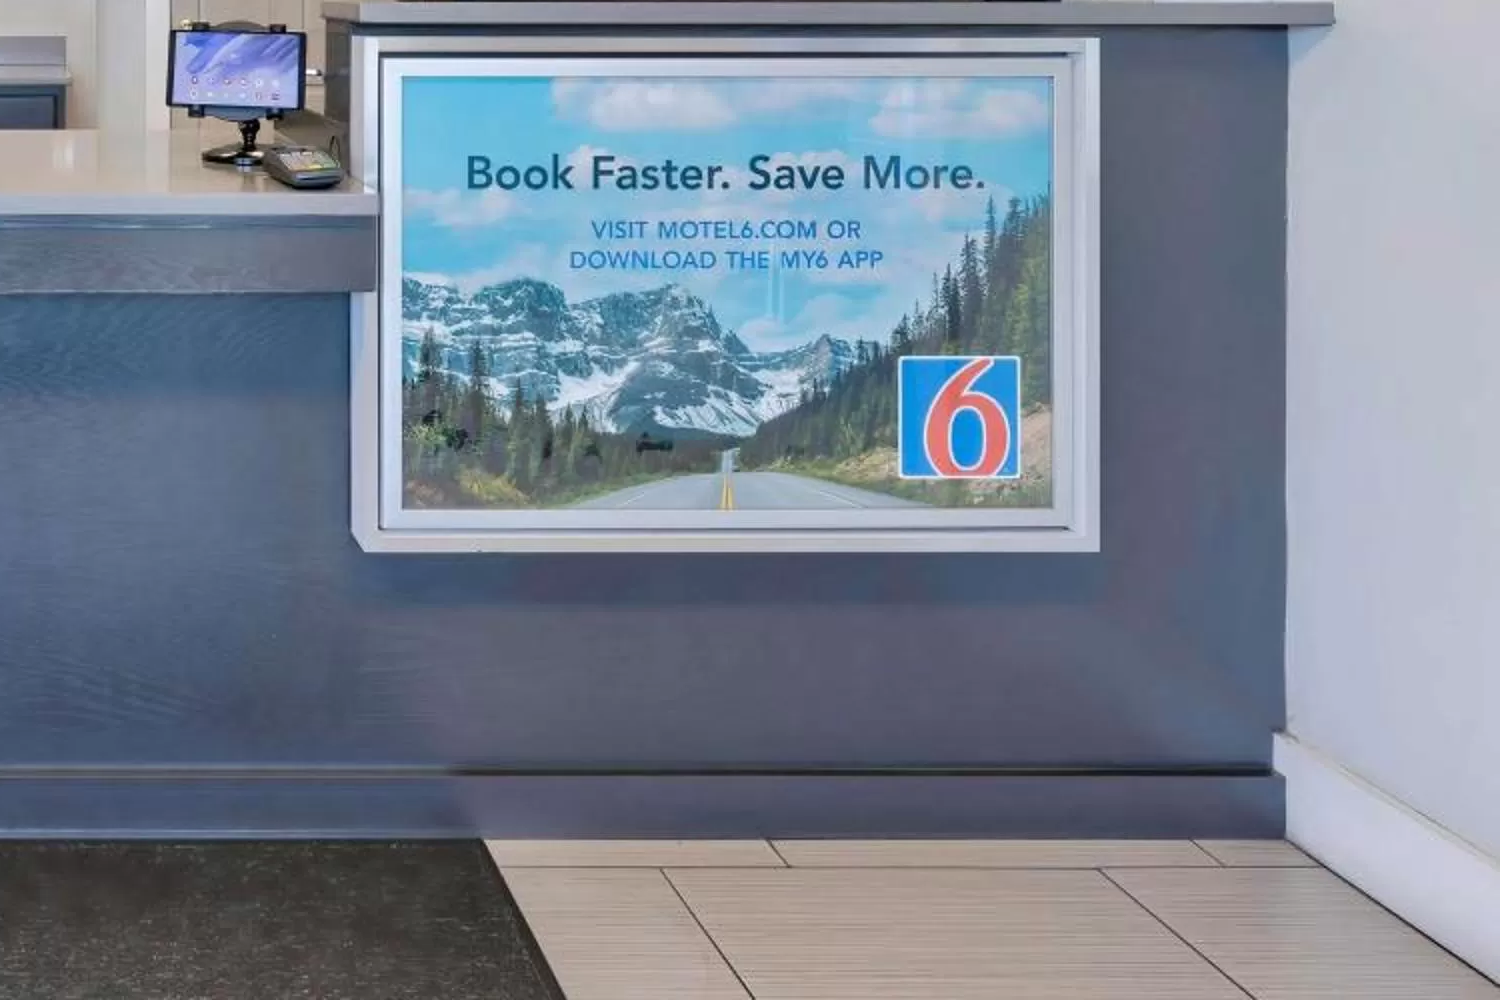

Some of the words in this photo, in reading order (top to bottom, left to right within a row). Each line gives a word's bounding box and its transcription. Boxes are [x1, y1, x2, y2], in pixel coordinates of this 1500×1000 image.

[466, 152, 575, 191] Book
[592, 155, 731, 191] Faster.
[747, 153, 845, 191] Save
[863, 154, 986, 191] More.
[591, 219, 649, 240] VISIT
[657, 219, 818, 240] MOTEL6.COM
[826, 219, 862, 240] OR
[569, 249, 717, 271] DOWNLOAD
[724, 250, 770, 271] THE
[780, 249, 829, 270] MY6
[837, 249, 884, 270] APP
[924, 356, 1011, 478] 6
